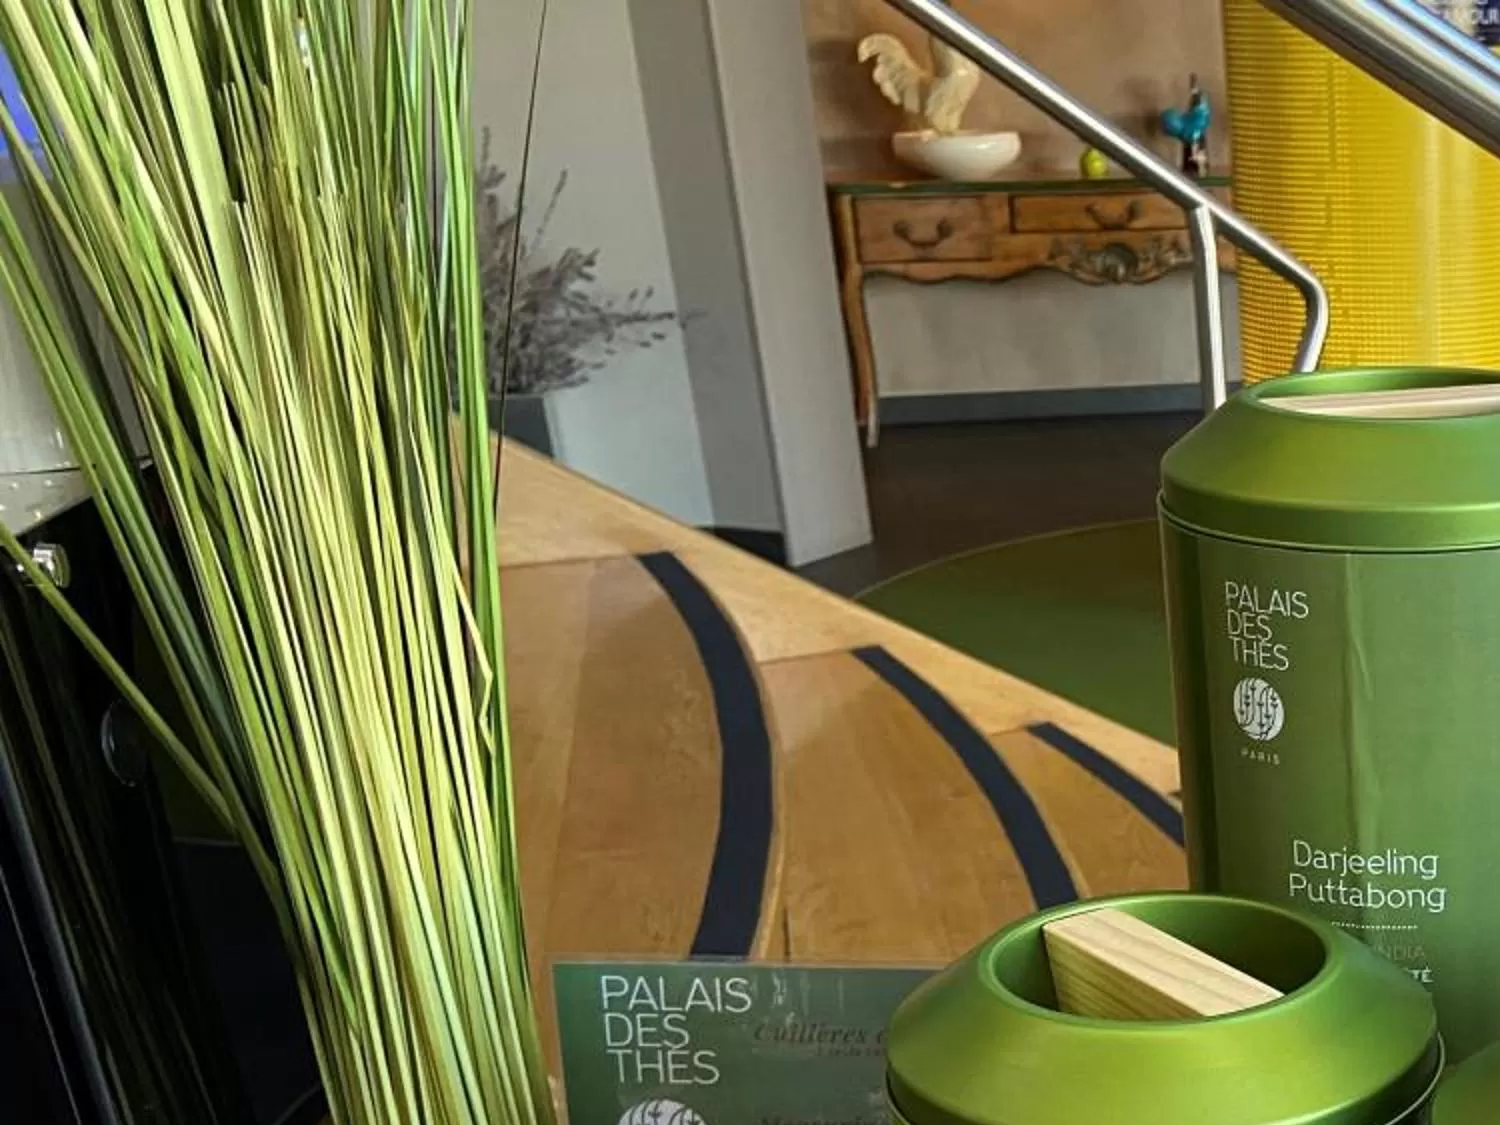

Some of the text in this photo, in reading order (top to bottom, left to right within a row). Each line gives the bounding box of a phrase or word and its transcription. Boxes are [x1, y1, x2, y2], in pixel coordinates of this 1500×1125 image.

[1224, 581, 1309, 619] PALAIS
[1227, 609, 1273, 641] DES
[1241, 747, 1280, 765] PARIS
[1292, 839, 1439, 880] Darjeeling
[1288, 872, 1447, 913] Puttabong
[600, 974, 752, 1013] PALAIS
[604, 1012, 690, 1048] DES
